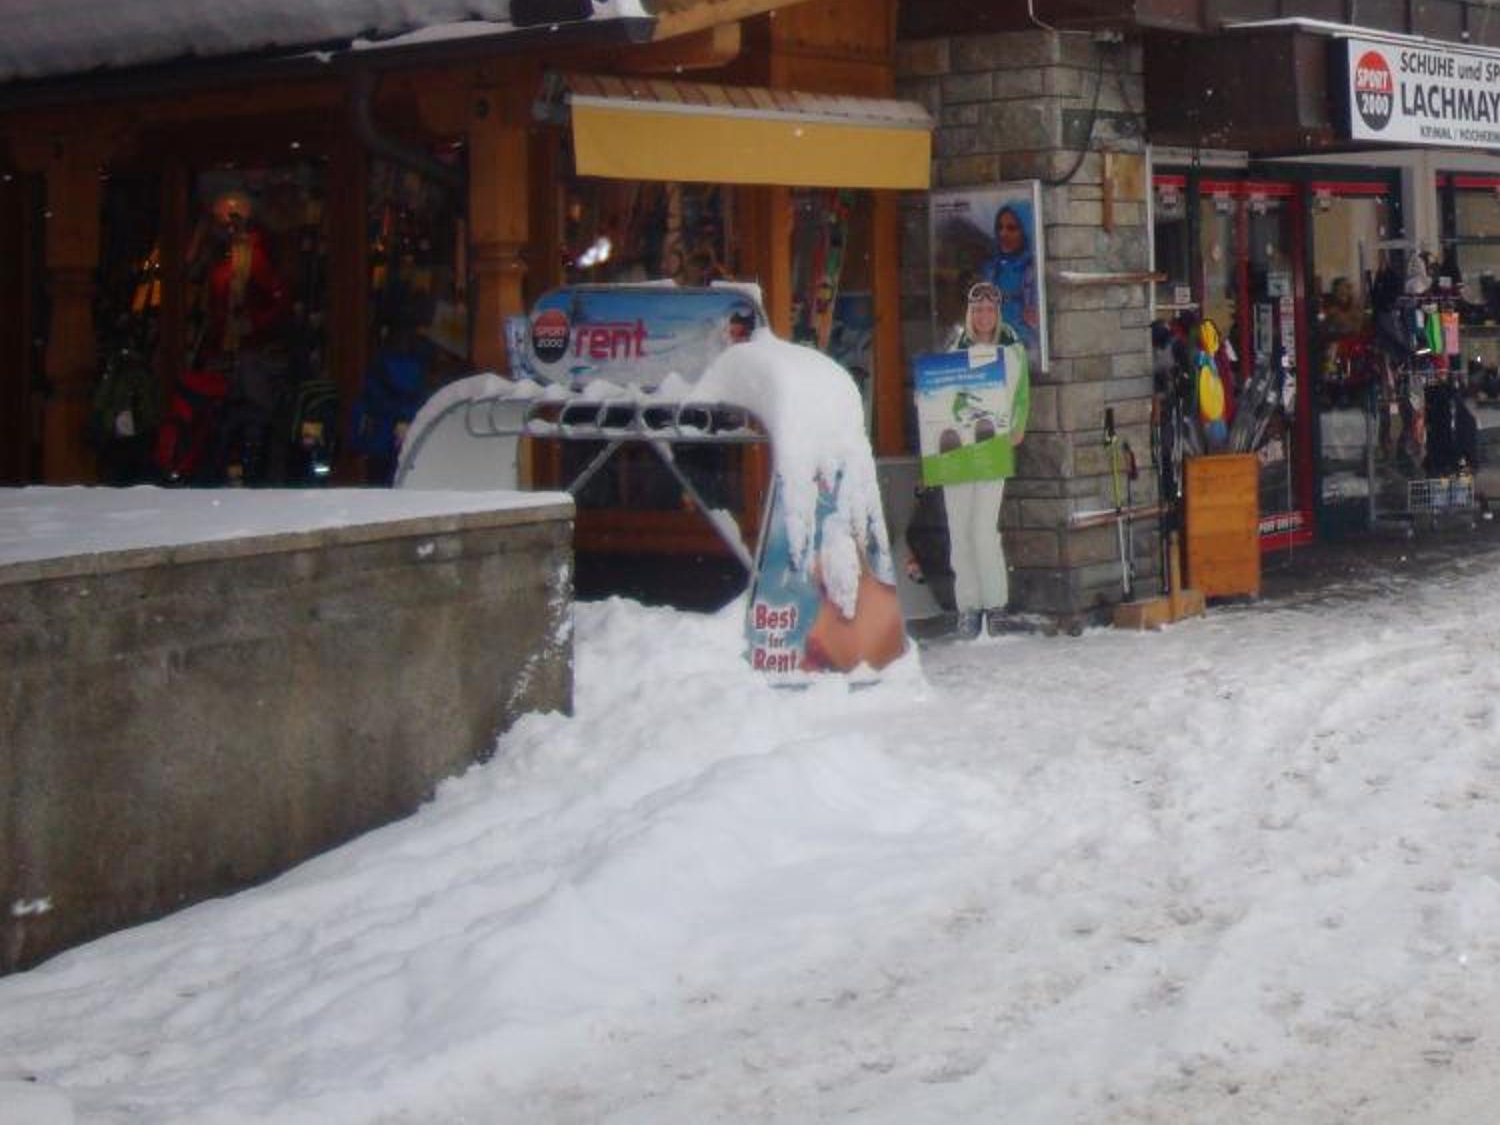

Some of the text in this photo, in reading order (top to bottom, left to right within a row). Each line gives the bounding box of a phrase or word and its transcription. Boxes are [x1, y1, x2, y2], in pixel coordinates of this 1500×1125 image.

[1400, 51, 1454, 78] SCHUHE
[1458, 60, 1482, 82] und
[1357, 68, 1389, 91] SPORT
[1361, 93, 1389, 116] 2000
[537, 338, 563, 348] 2000
[575, 318, 648, 360] rent
[754, 603, 797, 630] Best
[768, 633, 785, 649] for
[753, 648, 799, 672] Rent
